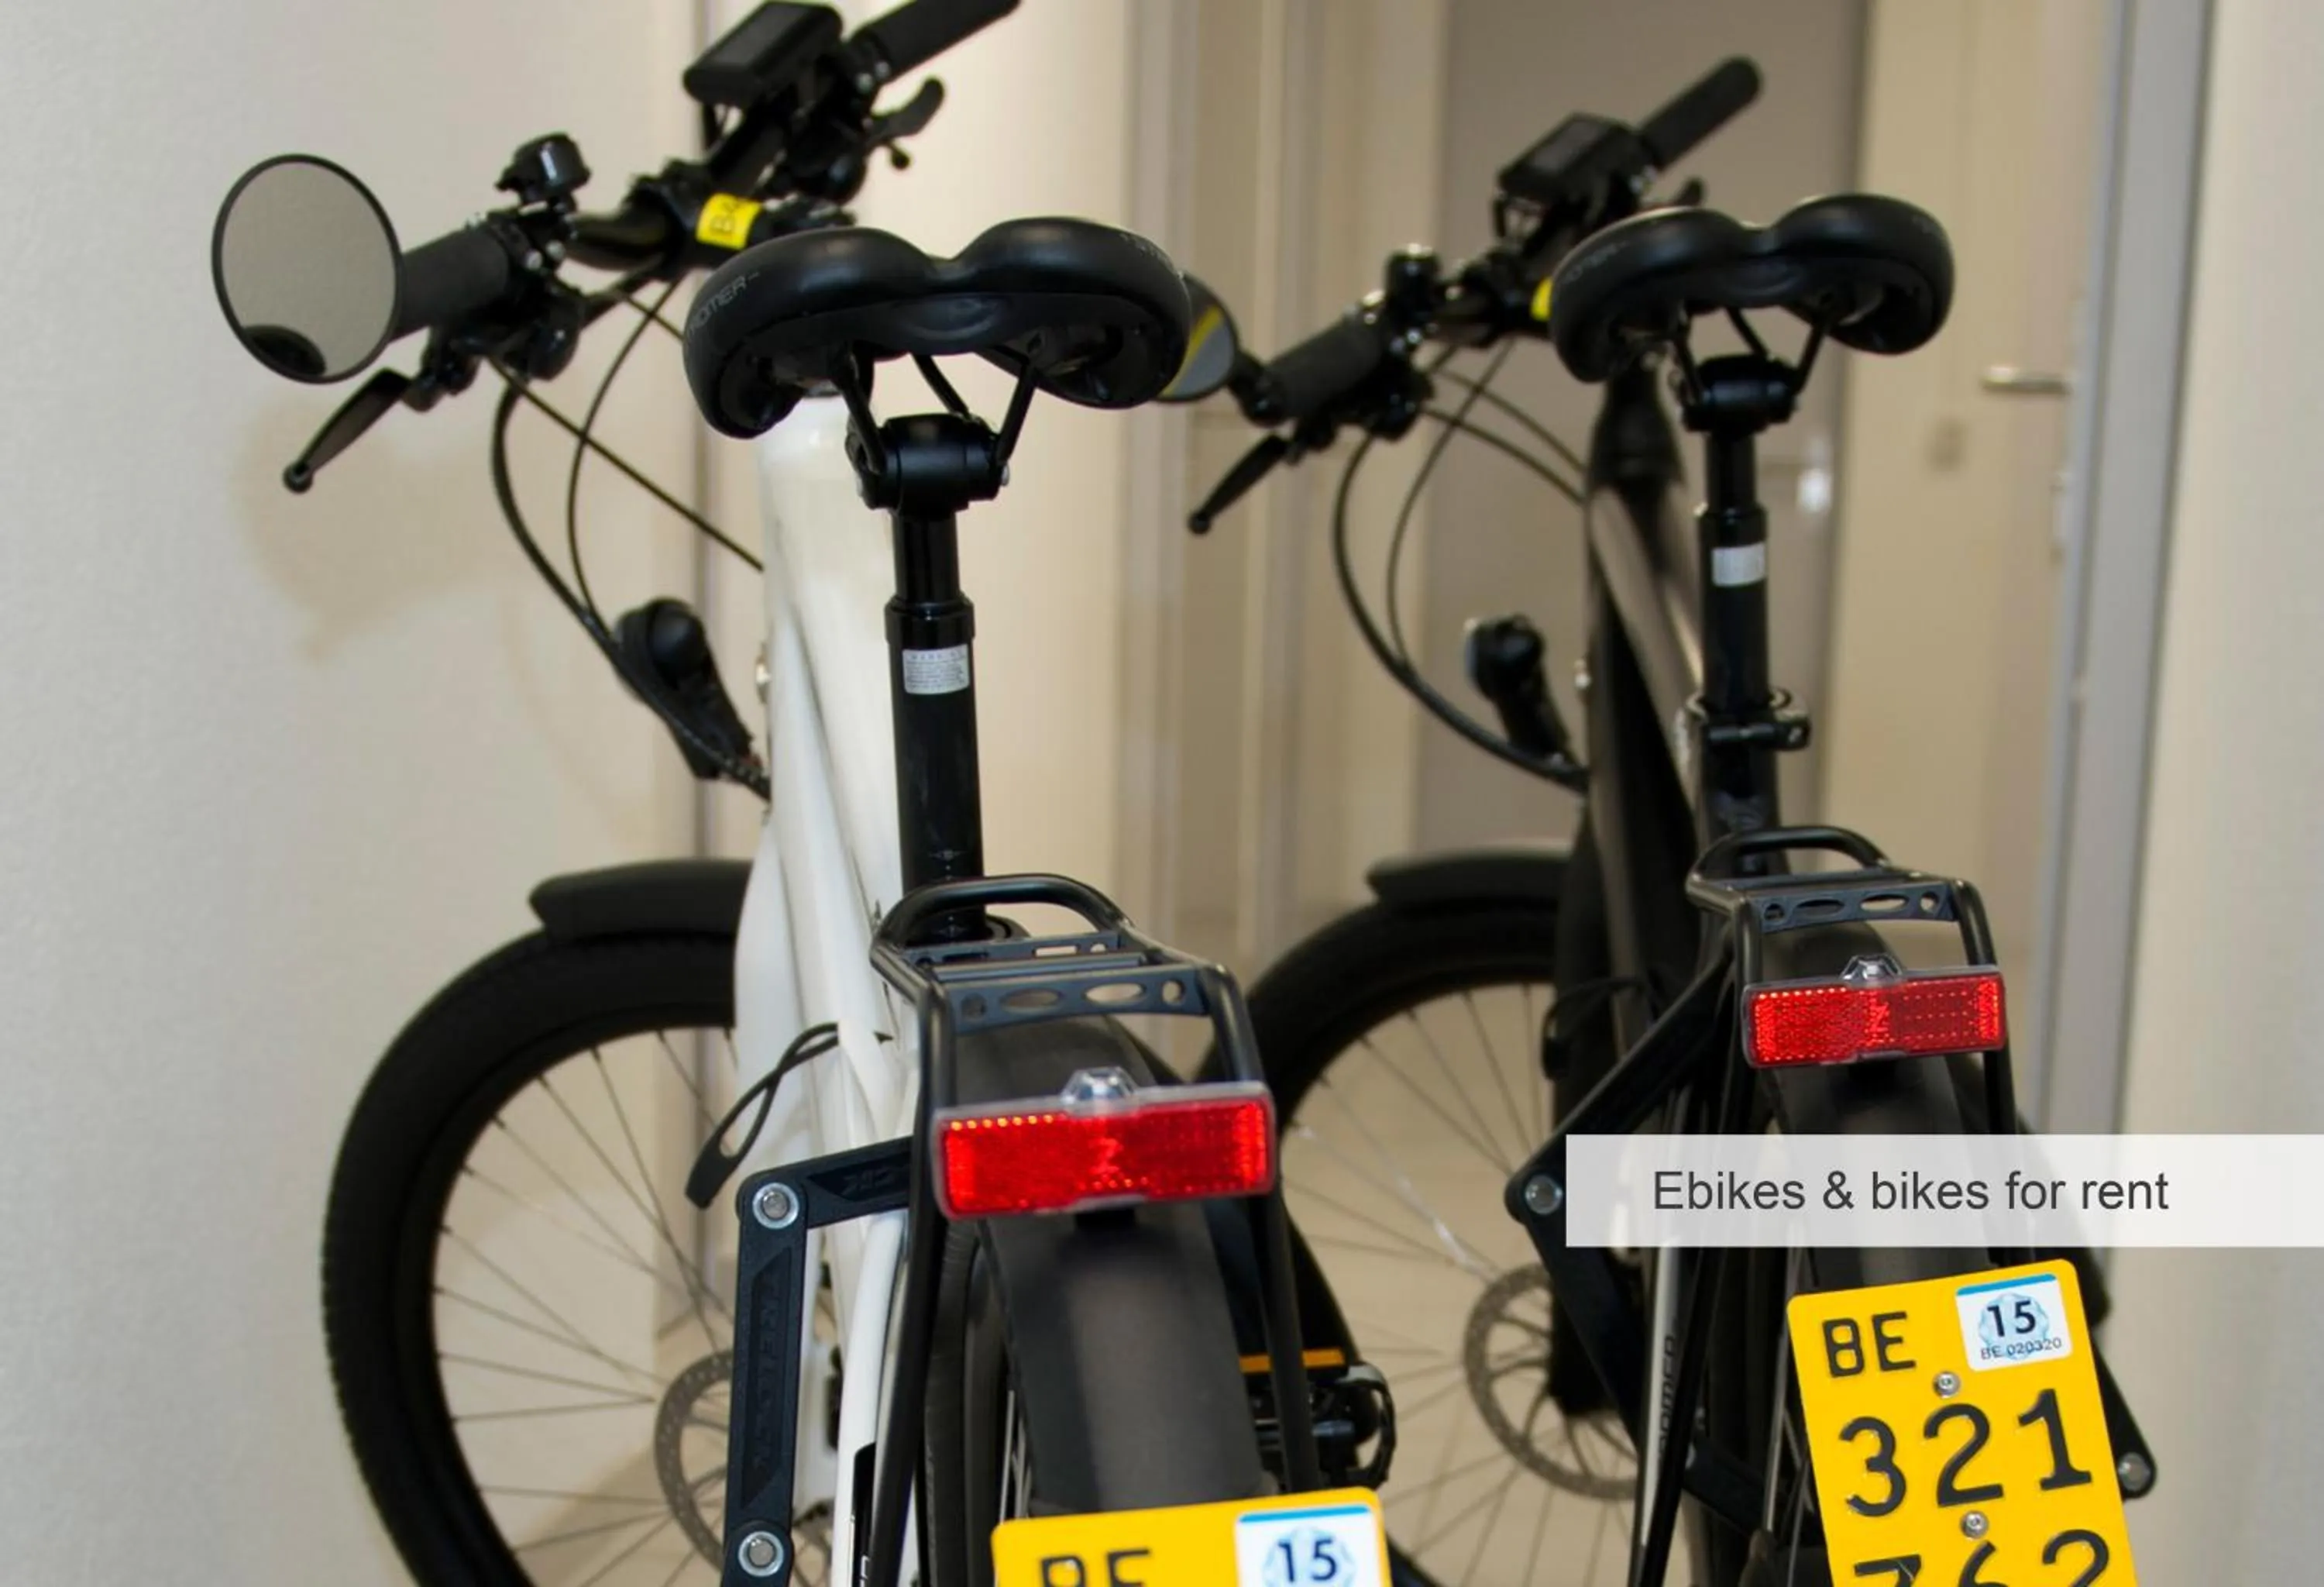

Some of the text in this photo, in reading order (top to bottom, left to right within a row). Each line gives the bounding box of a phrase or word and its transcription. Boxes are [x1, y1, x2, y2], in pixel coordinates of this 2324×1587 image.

[1985, 1299, 2036, 1337] 15
[1821, 1311, 1917, 1379] BE
[1980, 1344, 2003, 1360] BE
[1838, 1388, 2092, 1518] 321
[1277, 1537, 1339, 1584] 15
